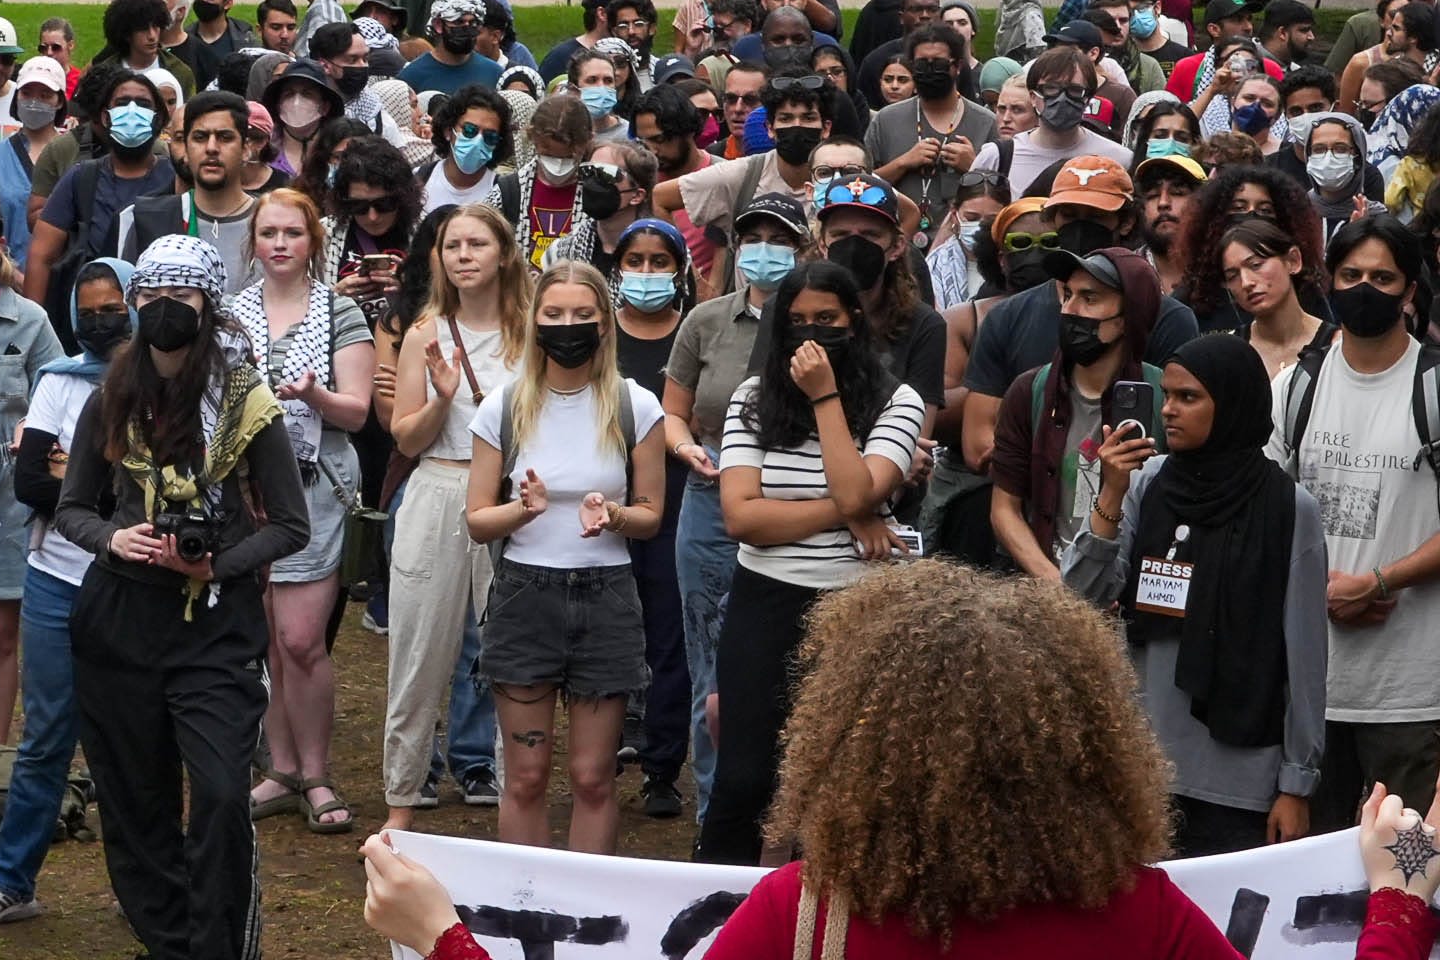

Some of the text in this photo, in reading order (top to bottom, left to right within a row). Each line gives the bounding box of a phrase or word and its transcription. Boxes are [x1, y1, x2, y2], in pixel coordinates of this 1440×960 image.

[548, 213, 556, 235] L
[1313, 431, 1352, 449] FREE
[1324, 450, 1410, 471] PALESTINE
[1141, 559, 1193, 578] PRESS
[1140, 576, 1183, 591] MARYAM
[1147, 592, 1176, 604] AHMED
